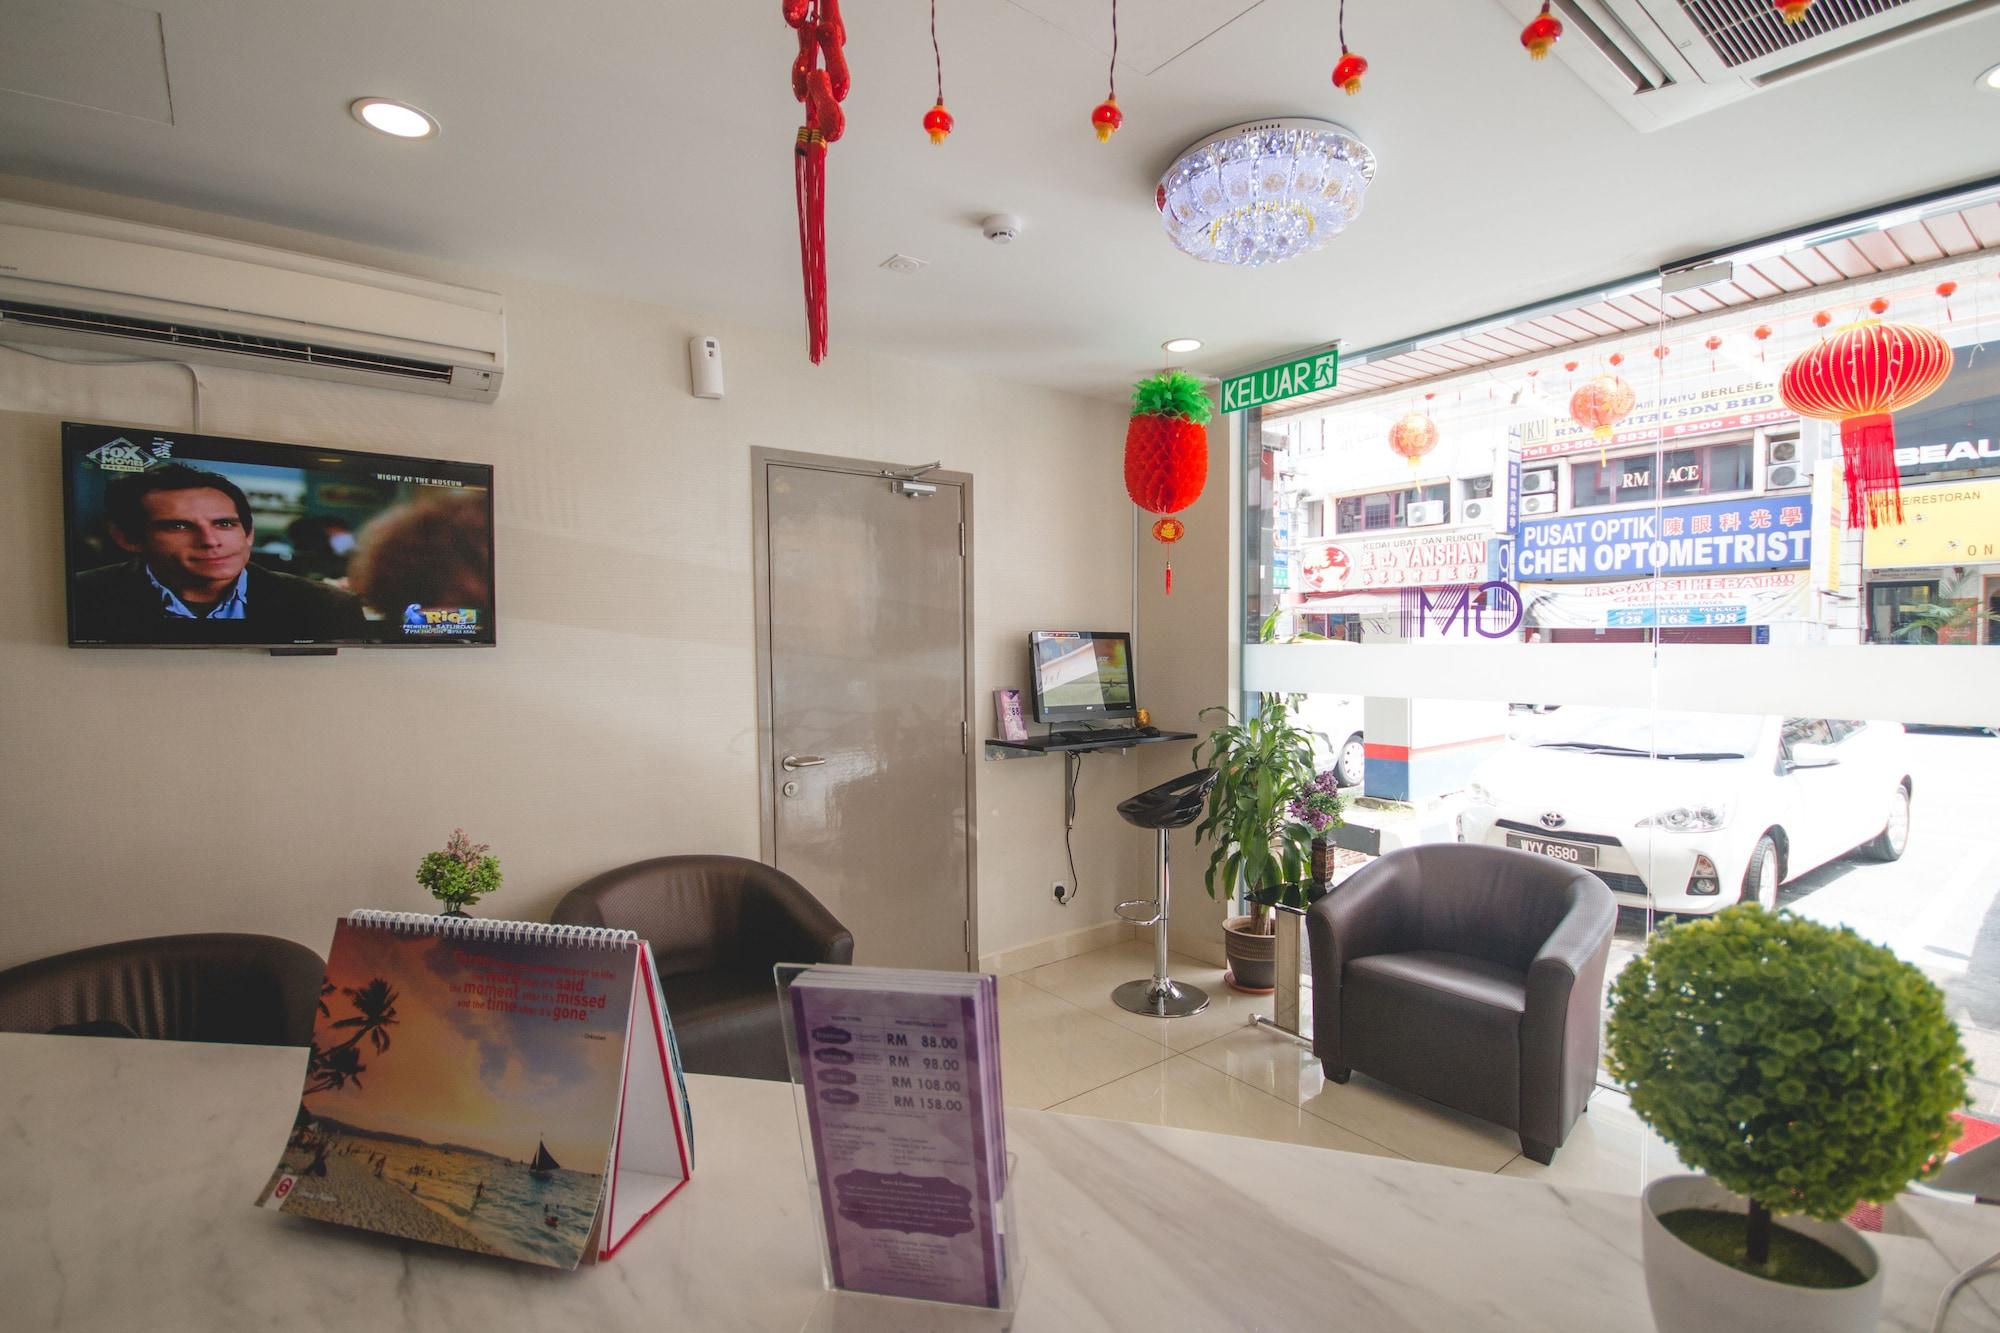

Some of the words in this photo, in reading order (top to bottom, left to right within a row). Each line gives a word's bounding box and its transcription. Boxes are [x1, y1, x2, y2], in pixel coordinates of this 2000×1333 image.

[1223, 362, 1311, 411] KELUAR
[1554, 426, 1584, 436] RM
[1678, 403, 1719, 417] SDN
[1726, 393, 1775, 410] BHD
[101, 446, 142, 459] FOX
[102, 457, 144, 466] MOVIES
[377, 473, 401, 482] NIGHT
[415, 476, 429, 484] THE
[431, 479, 462, 487] MUSEUM
[1622, 471, 1650, 488] RM
[1666, 465, 1699, 483] ACE
[1663, 506, 1803, 537] 陳眼科光學
[1524, 521, 1586, 548] PUSAT
[1591, 515, 1656, 541] OPTIK
[1363, 542, 1391, 551] KEDAI
[1422, 536, 1442, 545] DAN
[1446, 532, 1483, 542] RUNCIT
[1404, 540, 1487, 569] YANSHAN
[1518, 547, 1585, 575] CHEN
[1594, 530, 1811, 571] OPTOMETRIST
[1584, 579, 1687, 598] PROMOSI
[1691, 573, 1797, 592] HEBAT!!!
[1613, 593, 1677, 604] GREAT
[1684, 591, 1741, 601] DEAL
[424, 610, 460, 624] Rio
[1618, 615, 1643, 625] 128
[1660, 614, 1688, 624] 168
[1705, 613, 1737, 625] 198
[1521, 840, 1544, 855] WYY
[1547, 844, 1578, 860] 6580
[555, 977, 585, 992] said
[463, 981, 519, 999] moment
[556, 992, 607, 1009] missed
[487, 998, 517, 1012] time
[887, 1033, 908, 1046] RM
[921, 1035, 958, 1049] 88.00
[889, 1055, 910, 1068] RM
[923, 1057, 960, 1071] 98.00
[891, 1076, 912, 1089] RM
[917, 1078, 961, 1092] 108.00
[894, 1095, 914, 1108] RM
[919, 1097, 963, 1112] 158.00
